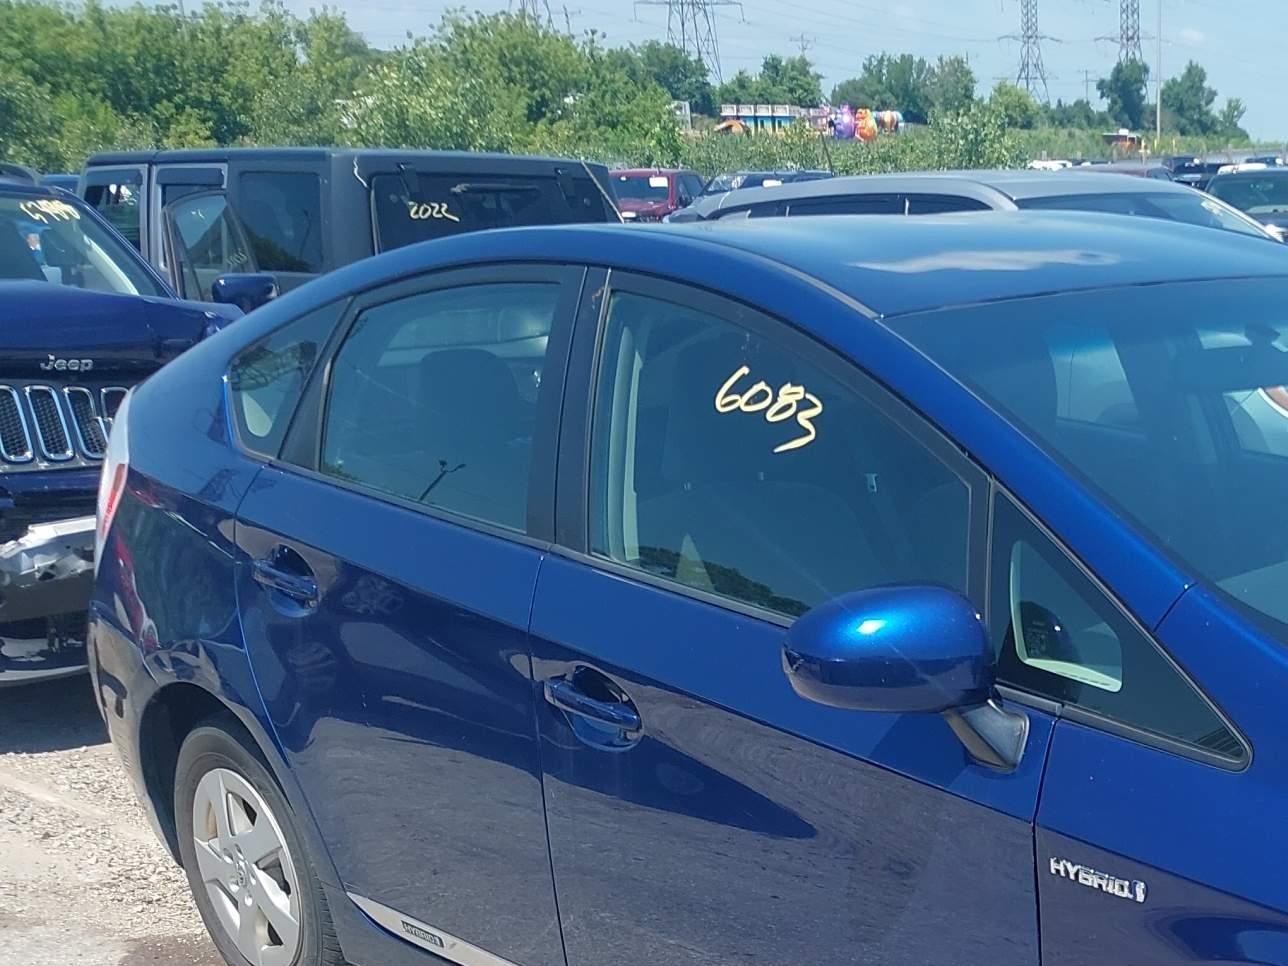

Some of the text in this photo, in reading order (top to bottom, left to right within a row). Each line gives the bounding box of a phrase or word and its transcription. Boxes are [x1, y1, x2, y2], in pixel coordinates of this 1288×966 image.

[408, 201, 460, 222] 2022
[40, 354, 93, 372] Jeep
[715, 365, 823, 453] 6083
[1050, 857, 1134, 899] HYBRID
